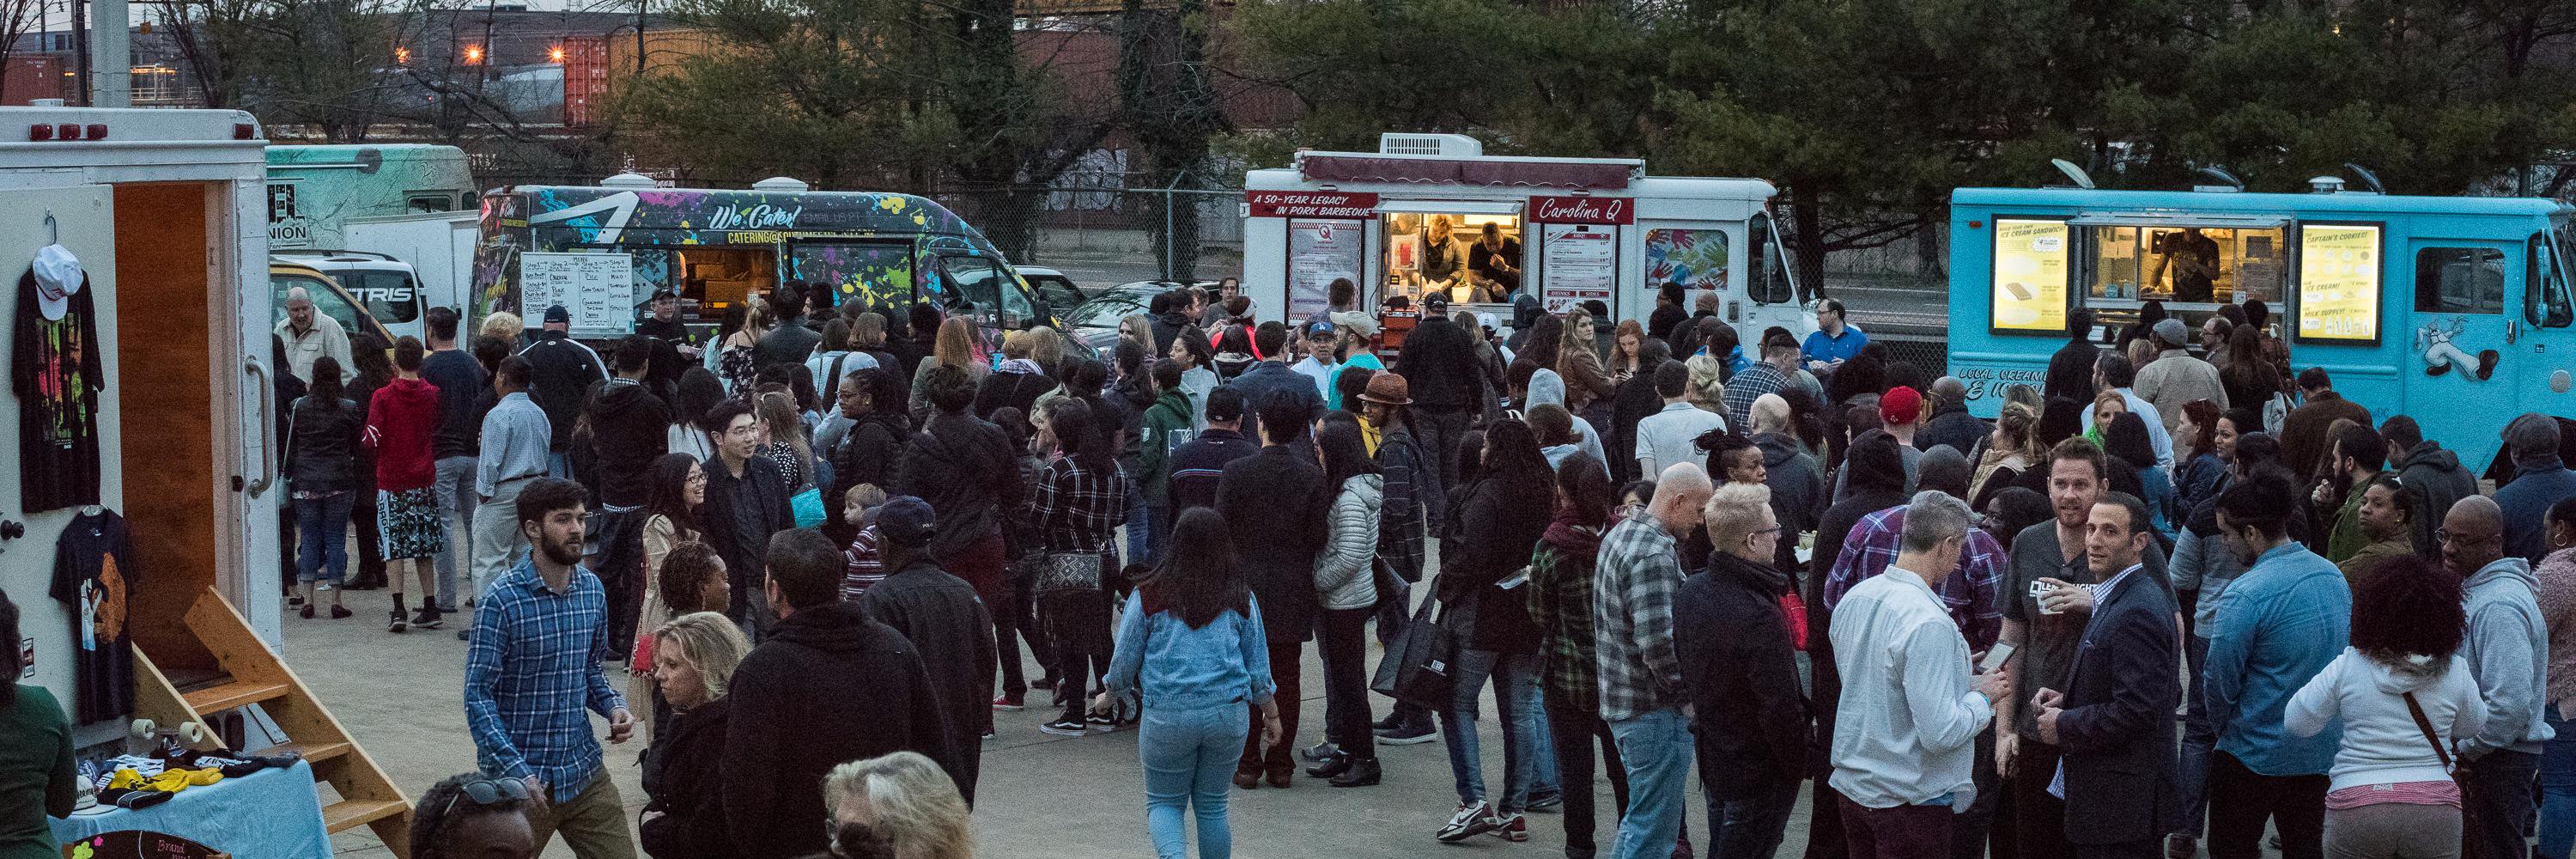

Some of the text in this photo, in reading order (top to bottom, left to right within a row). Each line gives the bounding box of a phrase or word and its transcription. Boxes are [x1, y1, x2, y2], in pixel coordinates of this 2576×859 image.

[1254, 194, 1349, 205] A 50-YEAR LEGACY
[1275, 206, 1373, 216] IN PORK BARBEQUE
[1539, 198, 1622, 221] Carolina Q
[709, 204, 803, 229] We Cater!
[268, 226, 307, 240] NION
[2010, 228, 2032, 237] CREAM
[2306, 231, 2368, 244] CAPTAIN'S COOKIES!
[1959, 368, 1995, 379] LOCAL
